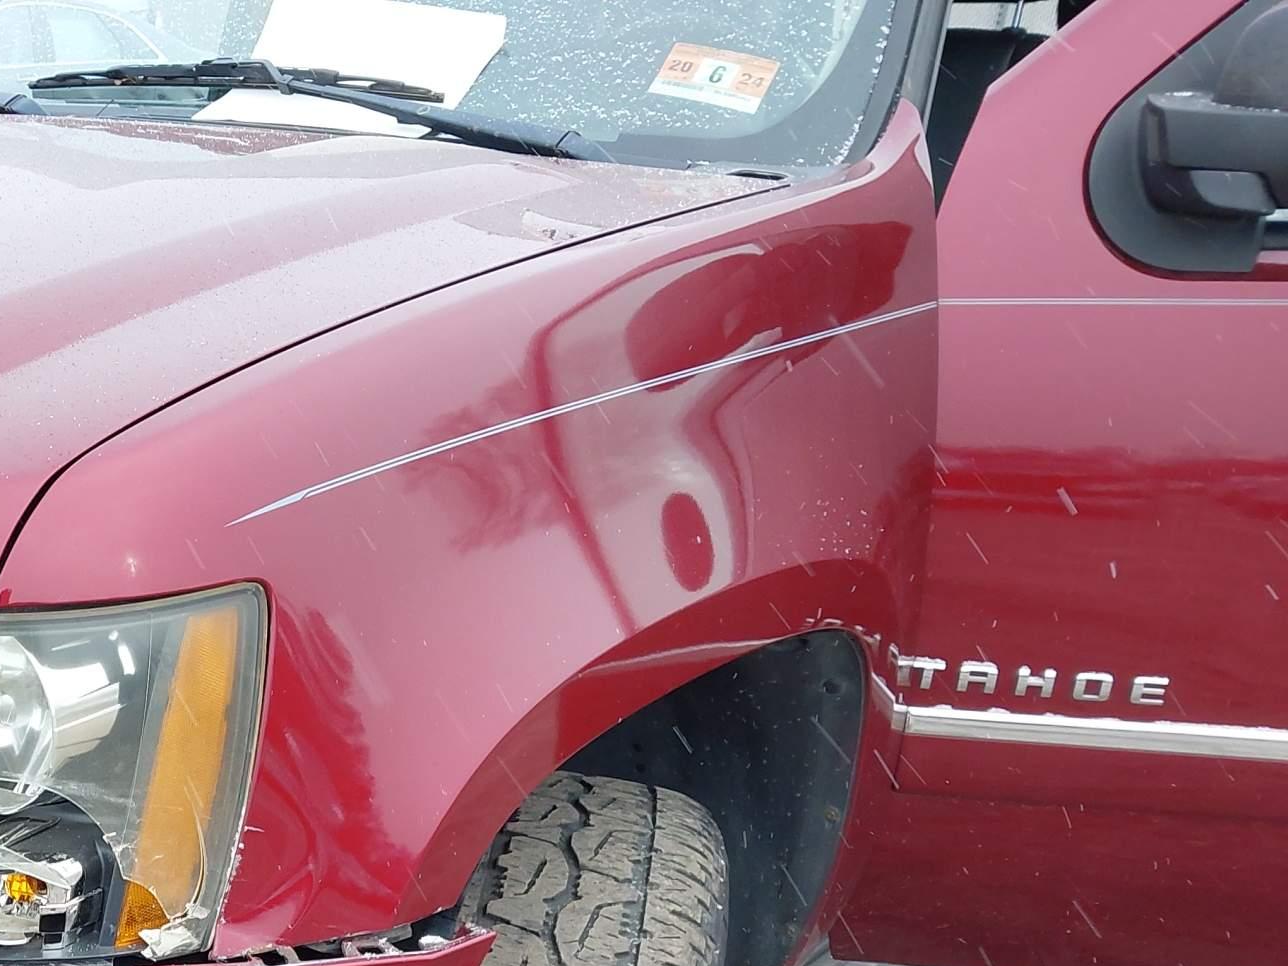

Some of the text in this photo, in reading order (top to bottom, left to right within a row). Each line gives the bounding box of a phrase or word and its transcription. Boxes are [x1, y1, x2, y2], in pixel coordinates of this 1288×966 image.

[668, 59, 765, 88] 20 6 24
[908, 655, 1170, 705] TAHOE
